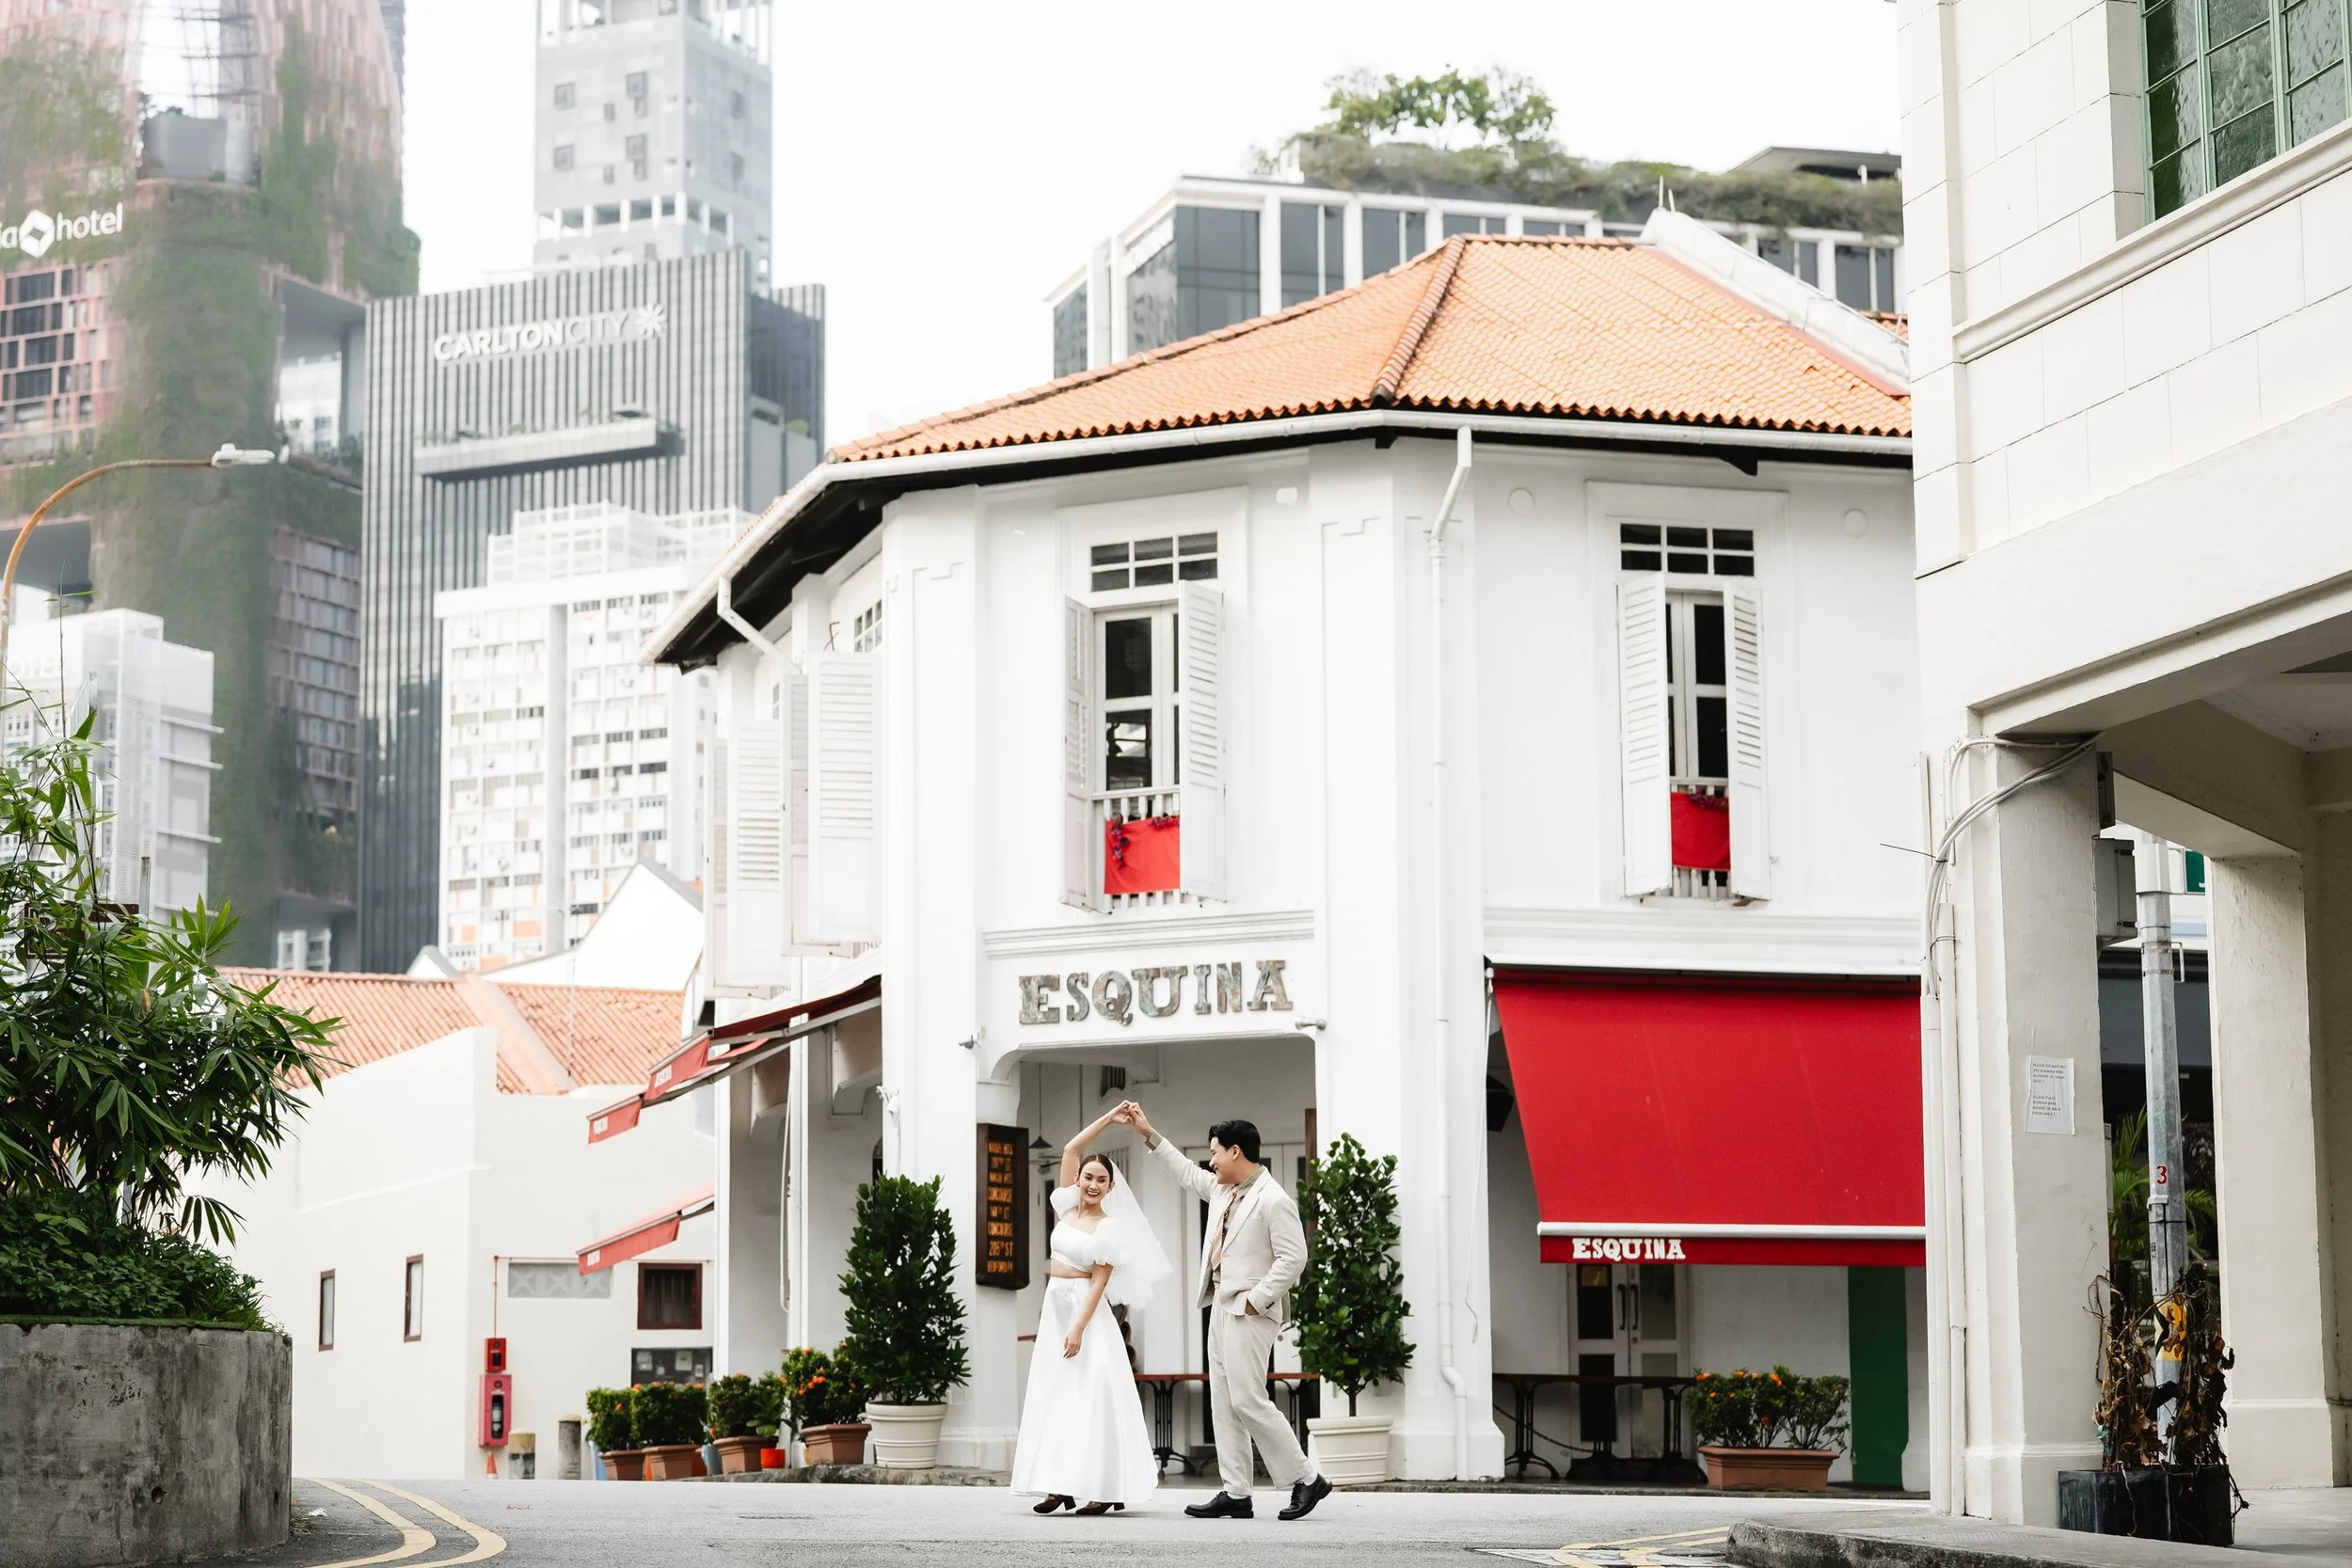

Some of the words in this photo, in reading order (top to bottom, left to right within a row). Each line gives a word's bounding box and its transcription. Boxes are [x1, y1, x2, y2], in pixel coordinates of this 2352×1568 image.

[56, 201, 123, 242] hotel
[1019, 959, 1293, 1026] ESQUINA
[2156, 1164, 2168, 1185] 3
[1572, 1238, 1686, 1261] ESQUINA
